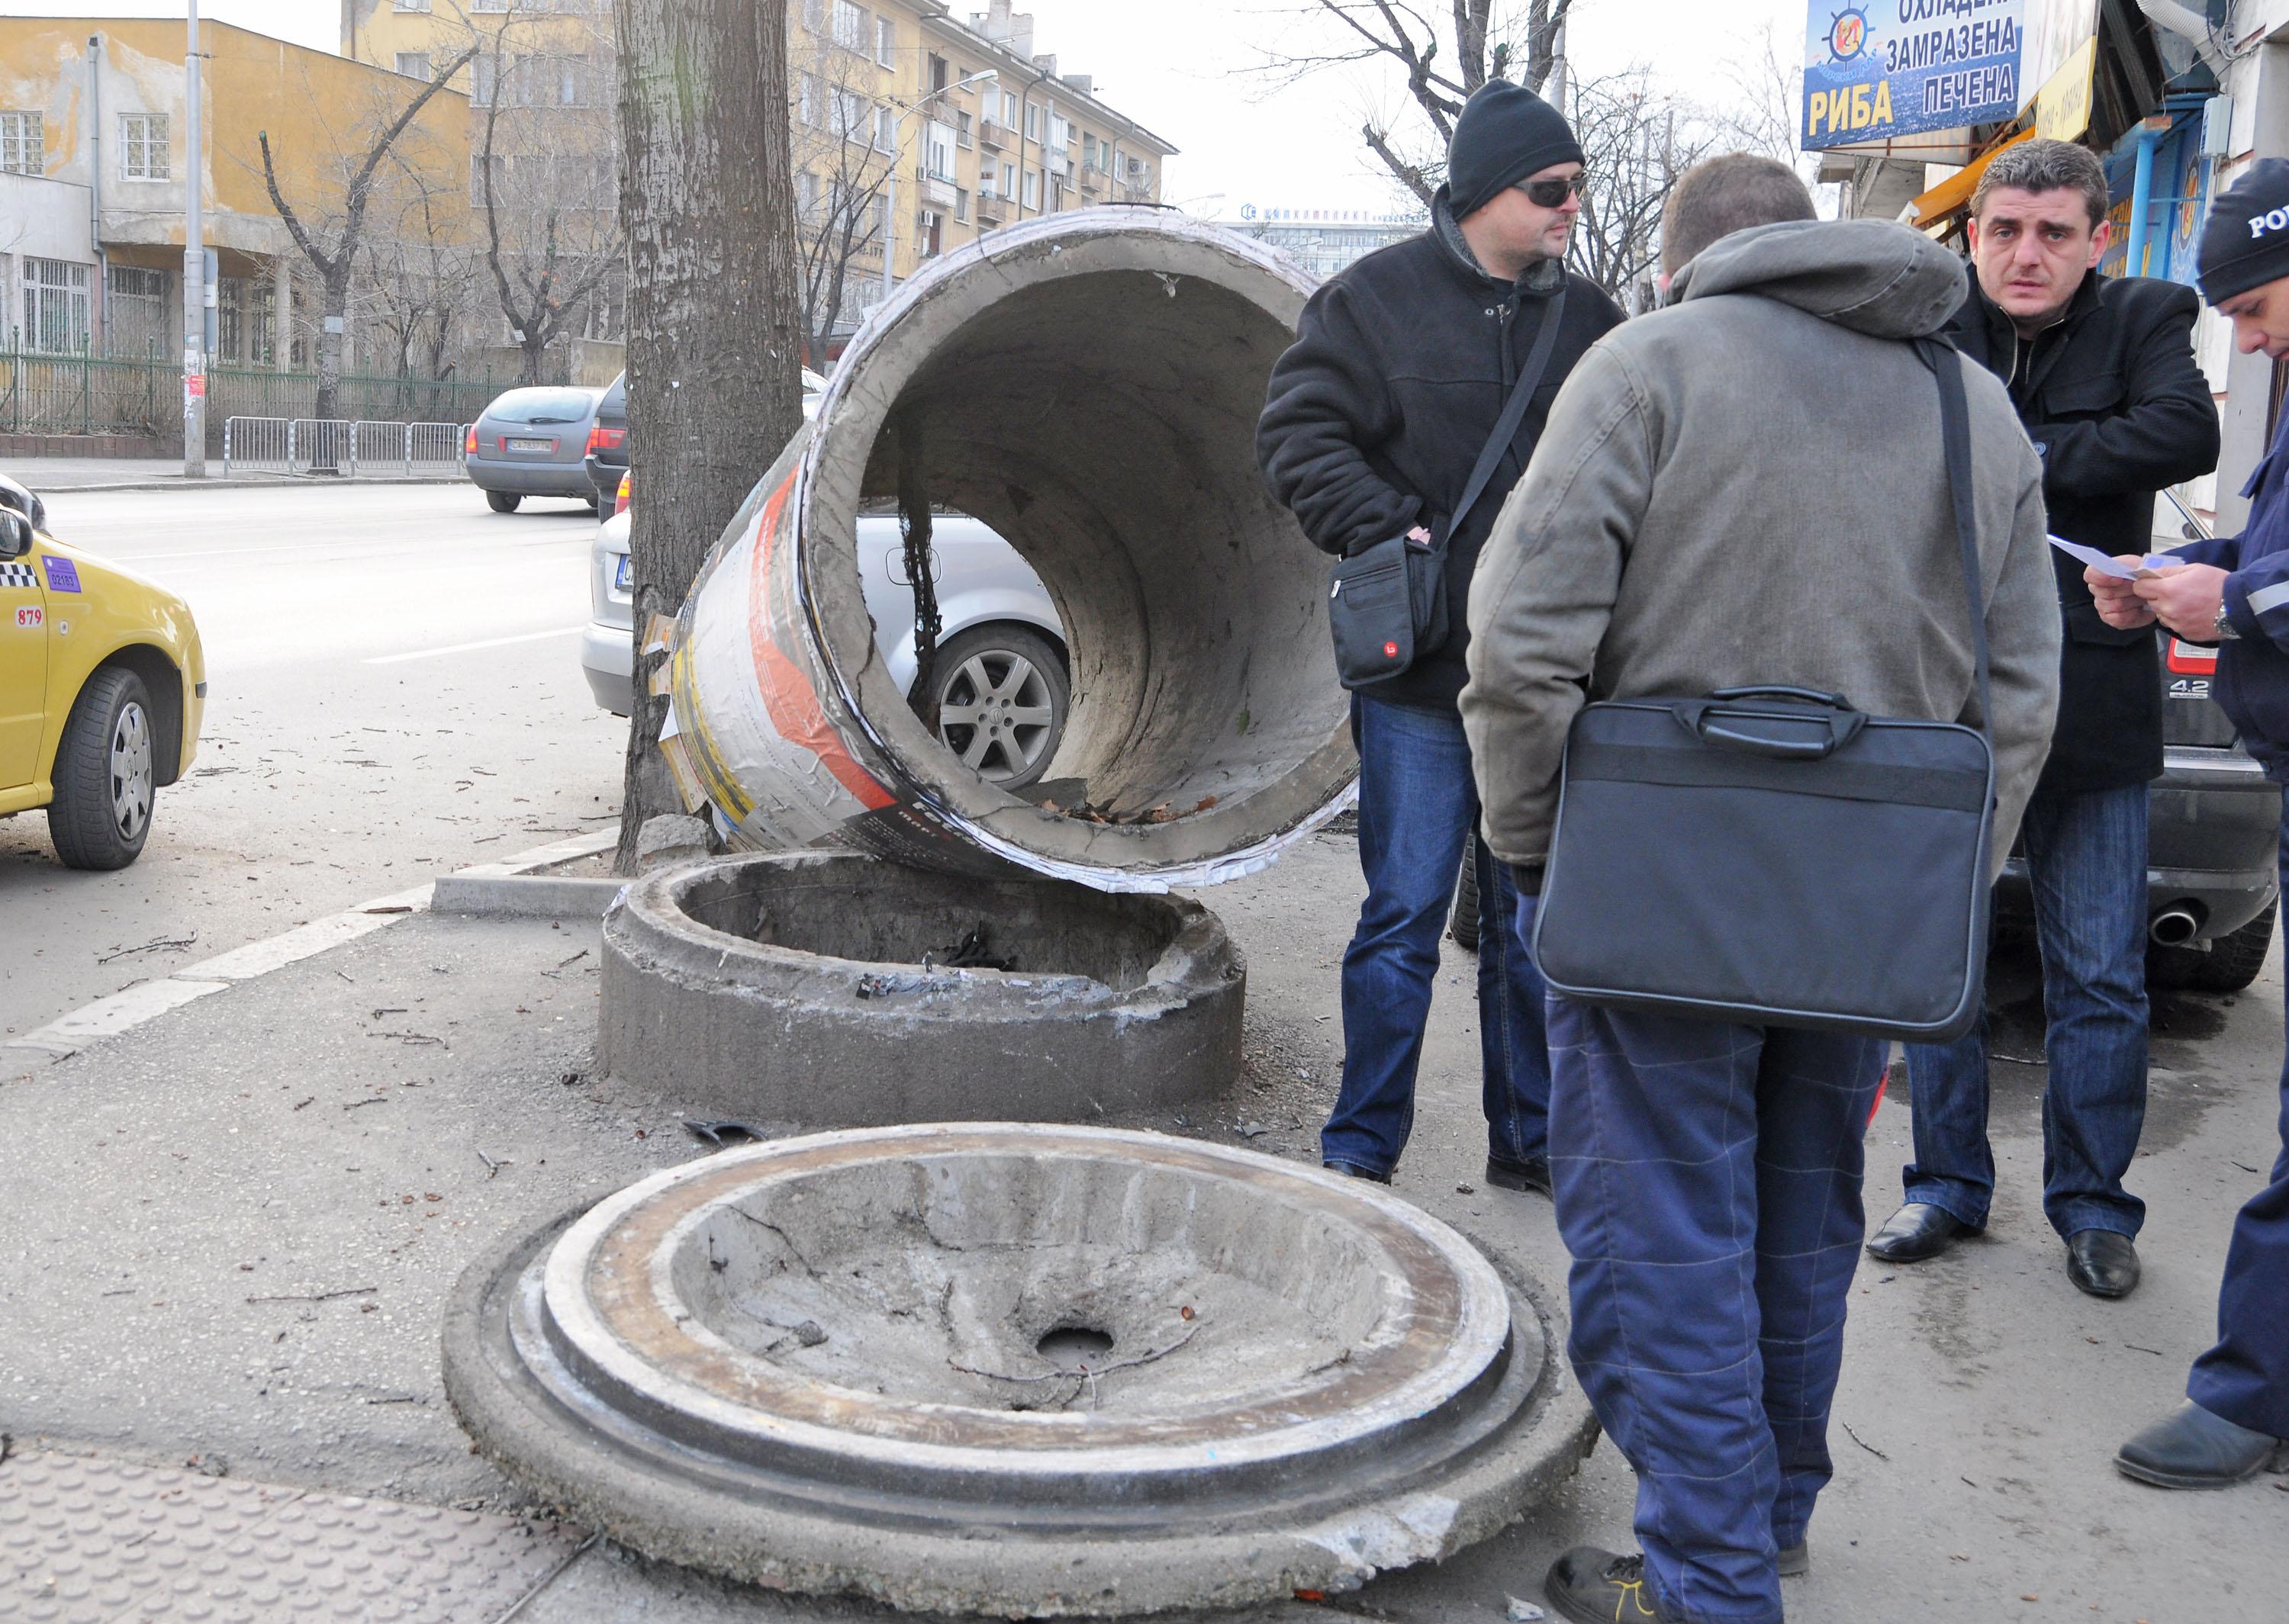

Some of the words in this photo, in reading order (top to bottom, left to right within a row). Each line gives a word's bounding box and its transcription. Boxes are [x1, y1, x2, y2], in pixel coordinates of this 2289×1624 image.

[1898, 0, 2017, 24] ОХЛАД
[1885, 16, 2016, 72] ЗАМРАЗЕНА
[1924, 65, 2014, 114] ПЕЧЕНА
[1808, 80, 1893, 137] РИБА
[52, 574, 74, 587] 02183
[18, 609, 43, 625] 879
[2170, 680, 2209, 693] 4.2
